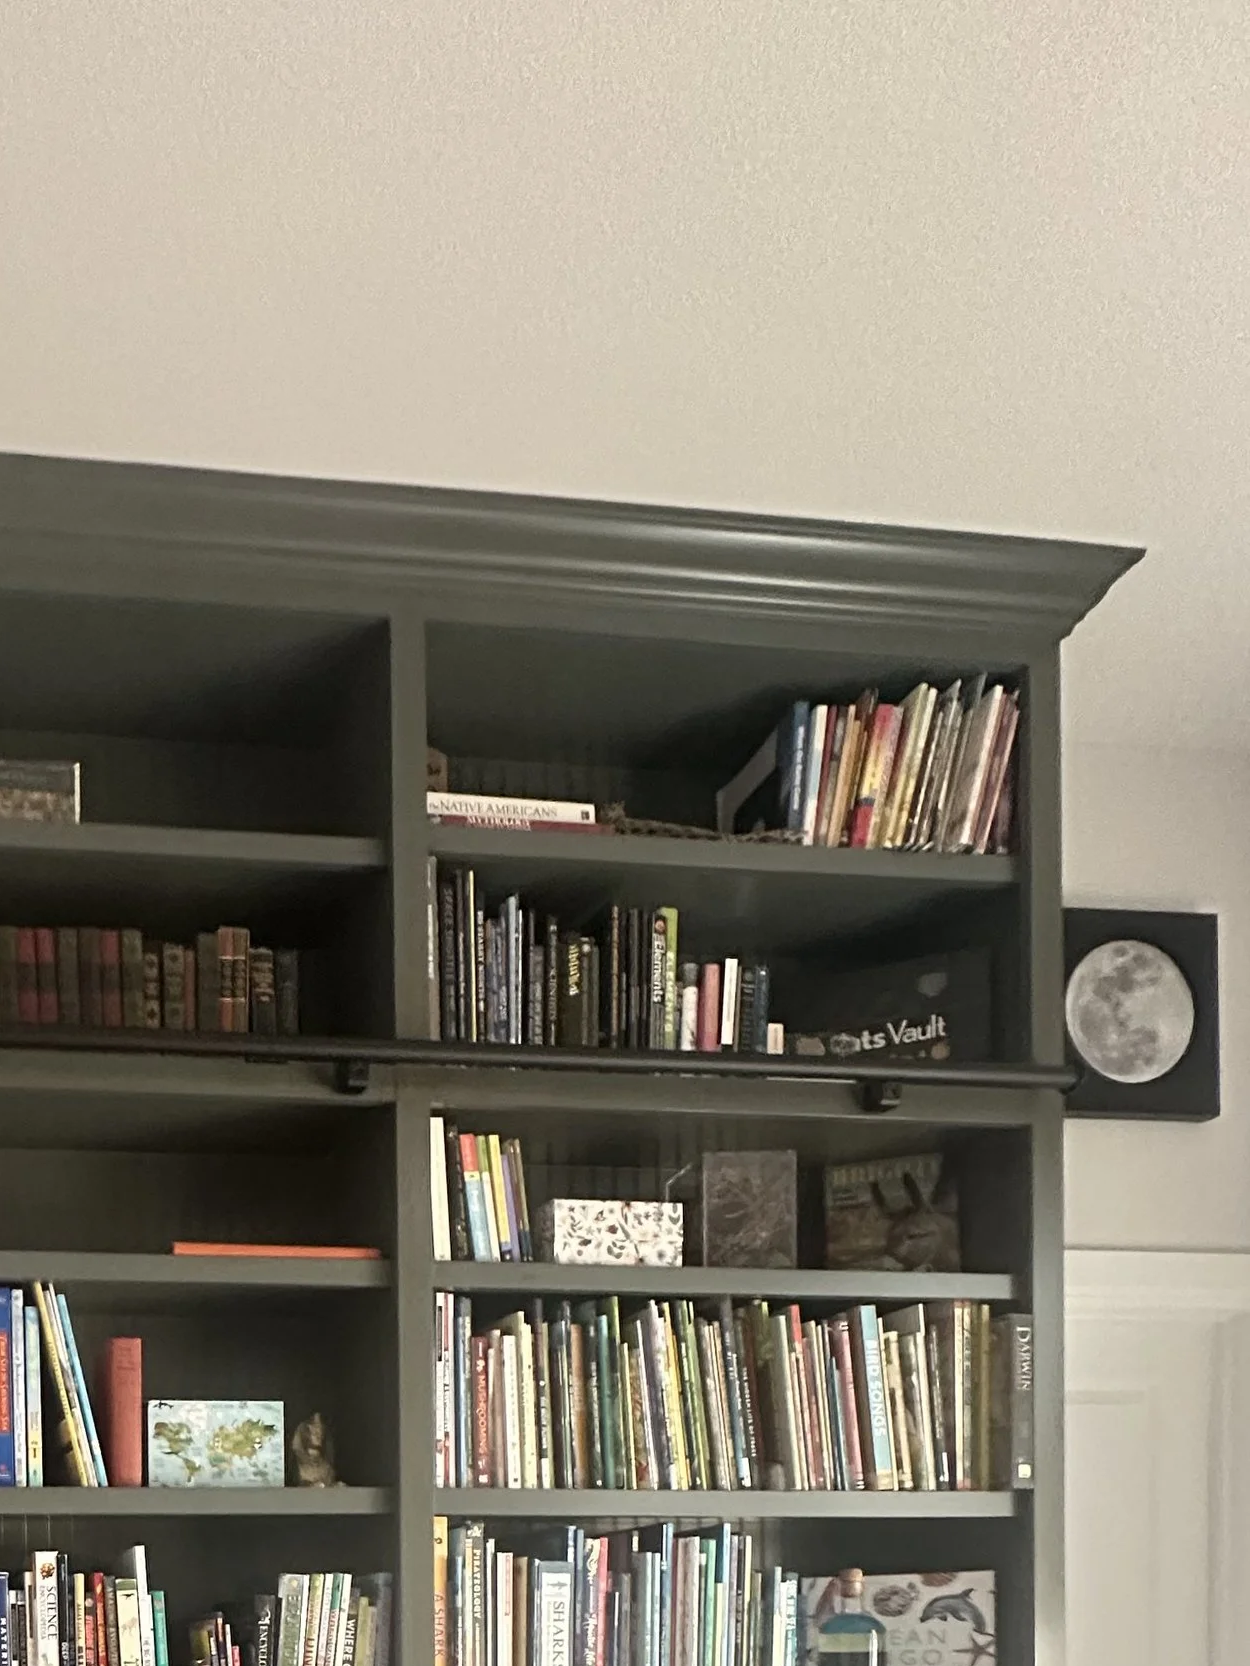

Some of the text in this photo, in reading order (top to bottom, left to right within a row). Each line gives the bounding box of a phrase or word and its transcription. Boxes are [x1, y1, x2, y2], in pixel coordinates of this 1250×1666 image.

[440, 799, 483, 814] NATIVE
[486, 802, 558, 818] AMERICANS
[653, 941, 665, 1003] Elements
[665, 951, 675, 1032] ELEMENTS
[886, 1014, 946, 1045] Vault
[1015, 1326, 1032, 1391] DARWIN
[865, 1339, 887, 1438] BIRD SONGS
[472, 1549, 482, 1619] PIRATEOLOGY
[45, 1585, 57, 1640] SCIENCE
[434, 1608, 445, 1658] SHARK
[888, 1627, 947, 1647] EAN
[61, 1641, 69, 1659] DEEP
[342, 1618, 356, 1661] WHERE
